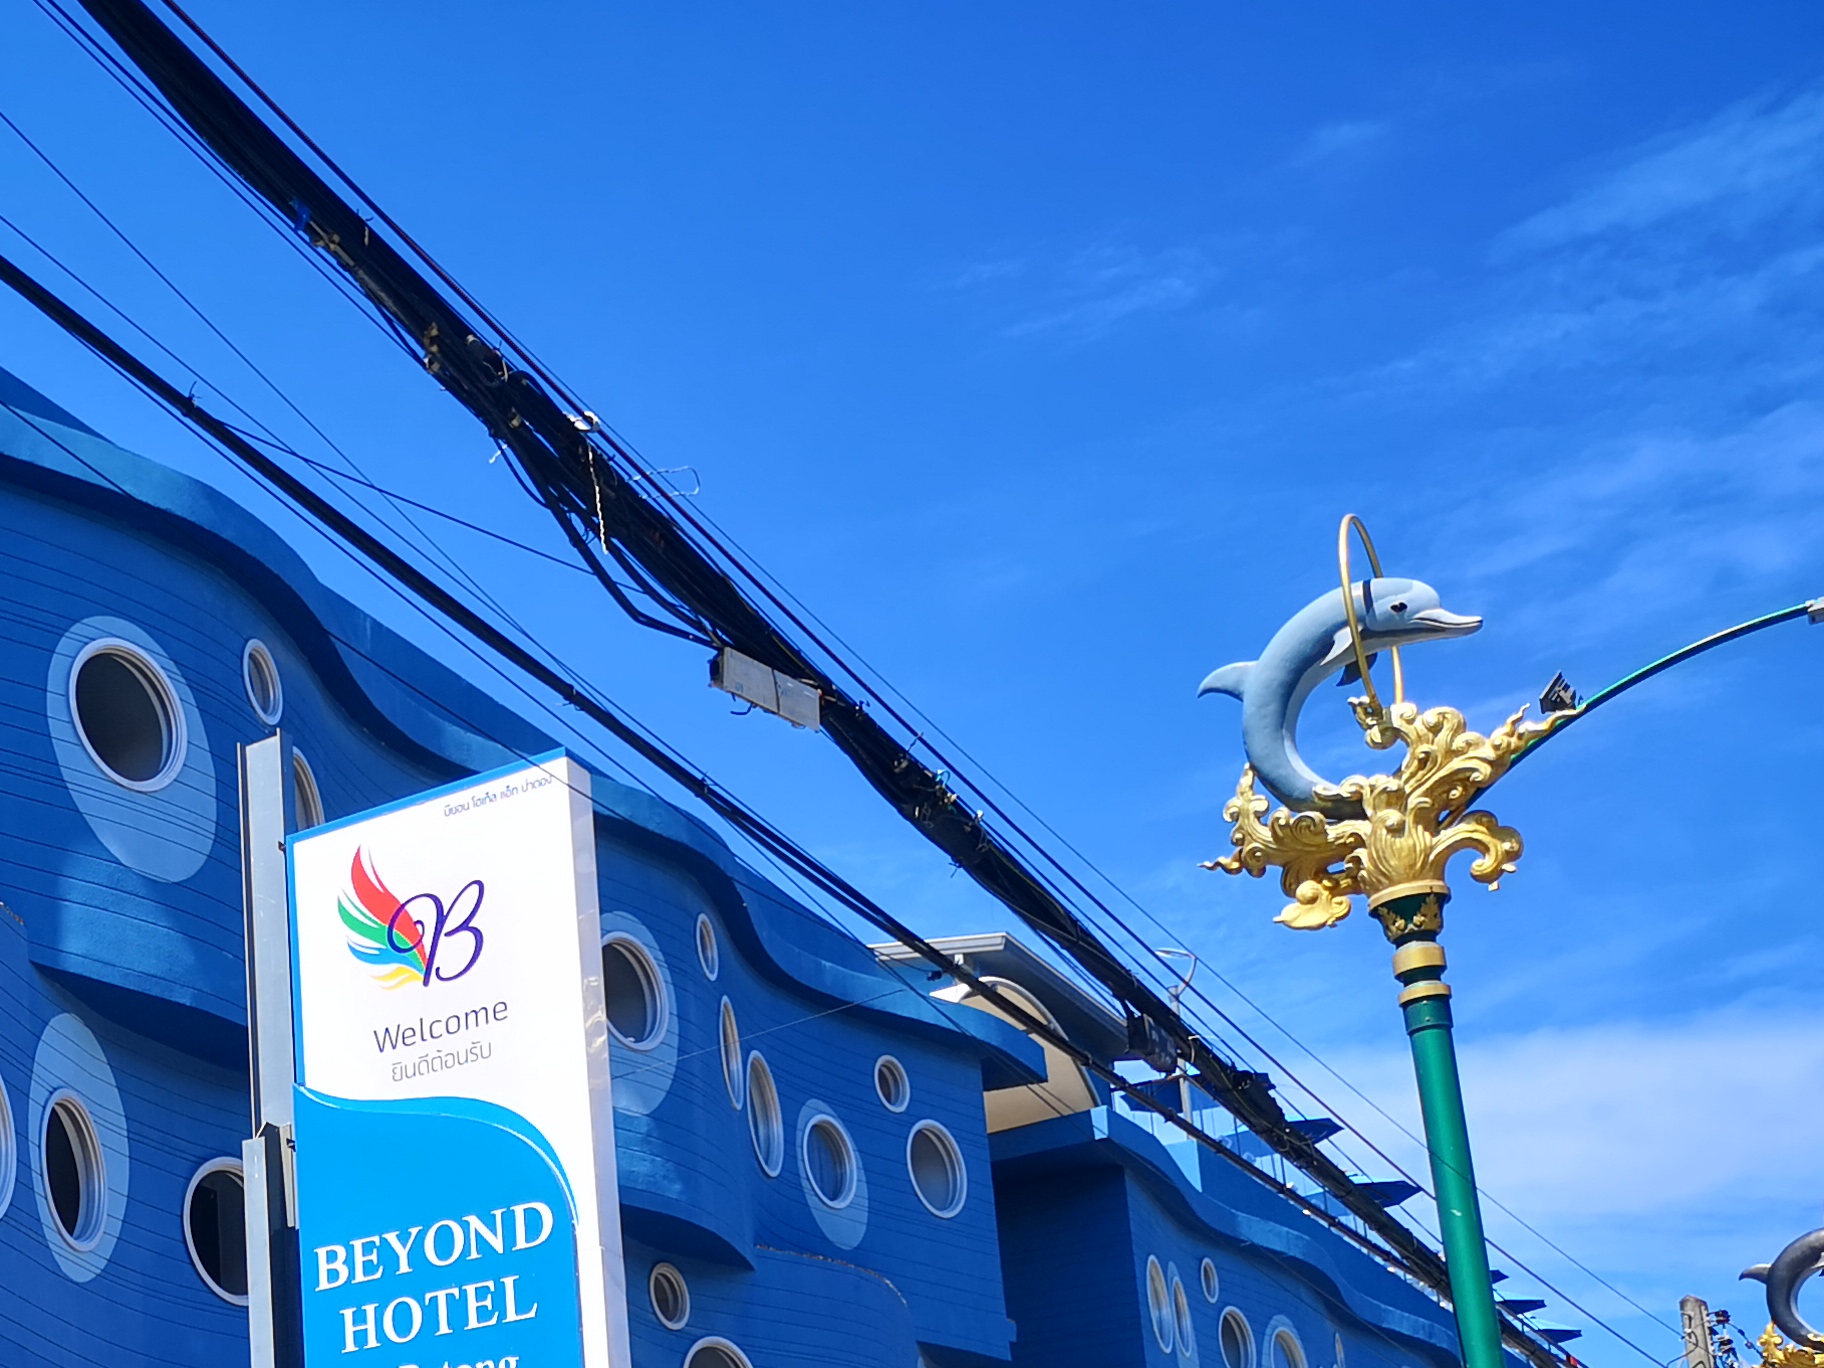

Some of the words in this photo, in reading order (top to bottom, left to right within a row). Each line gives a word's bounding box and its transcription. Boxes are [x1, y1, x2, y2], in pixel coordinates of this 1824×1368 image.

[373, 1000, 509, 1053] Welcome
[391, 1040, 492, 1082] ยินดีต้อนรับ
[314, 1201, 553, 1291] BEYOND
[339, 1275, 538, 1353] HOTEL
